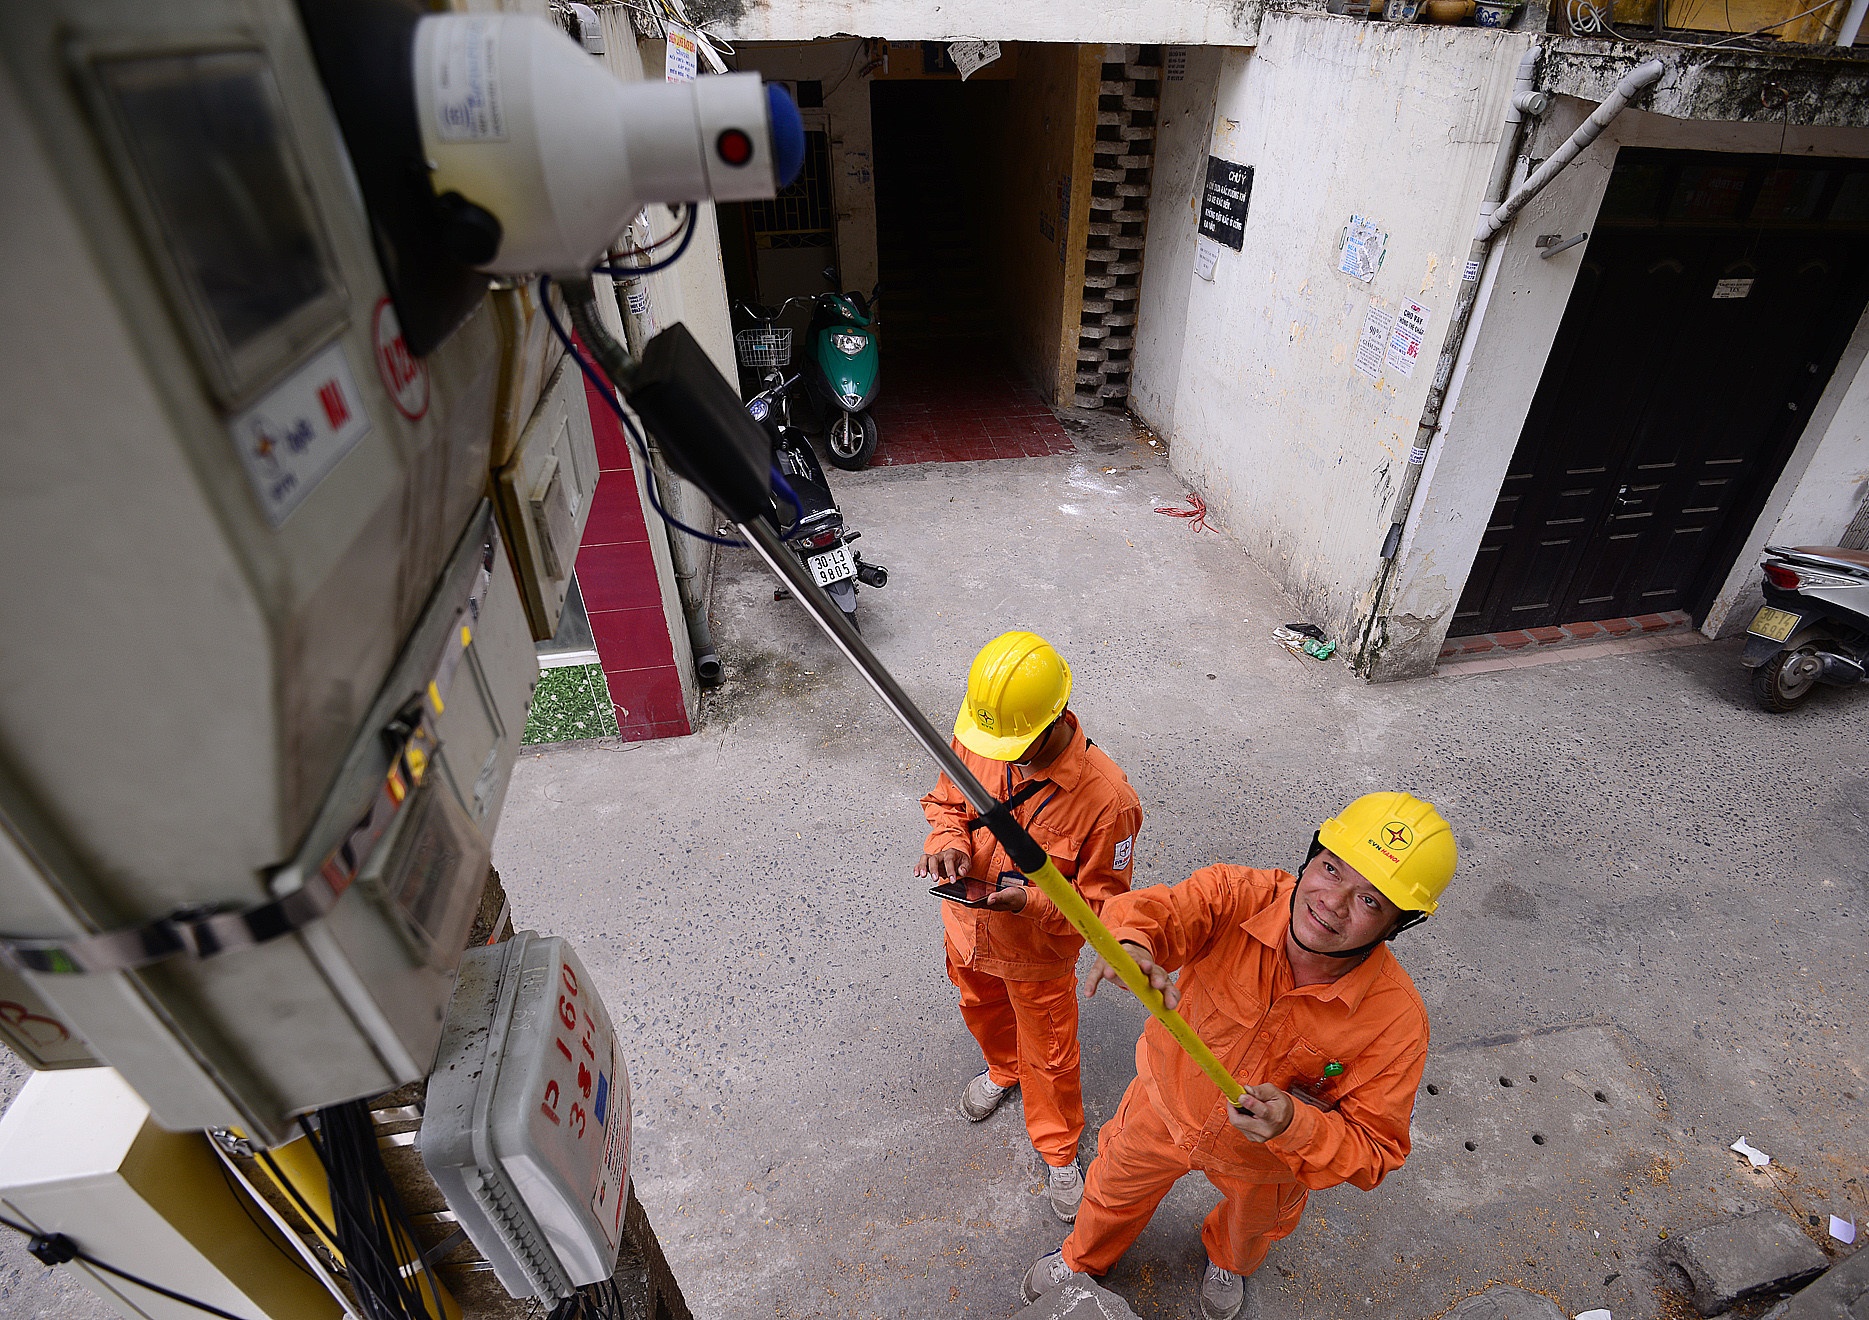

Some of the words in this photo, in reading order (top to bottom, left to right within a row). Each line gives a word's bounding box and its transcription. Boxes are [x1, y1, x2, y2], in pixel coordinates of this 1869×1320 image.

[1228, 169, 1241, 184] CHÚ
[1241, 170, 1247, 185] Ý
[819, 562, 851, 583] 9805
